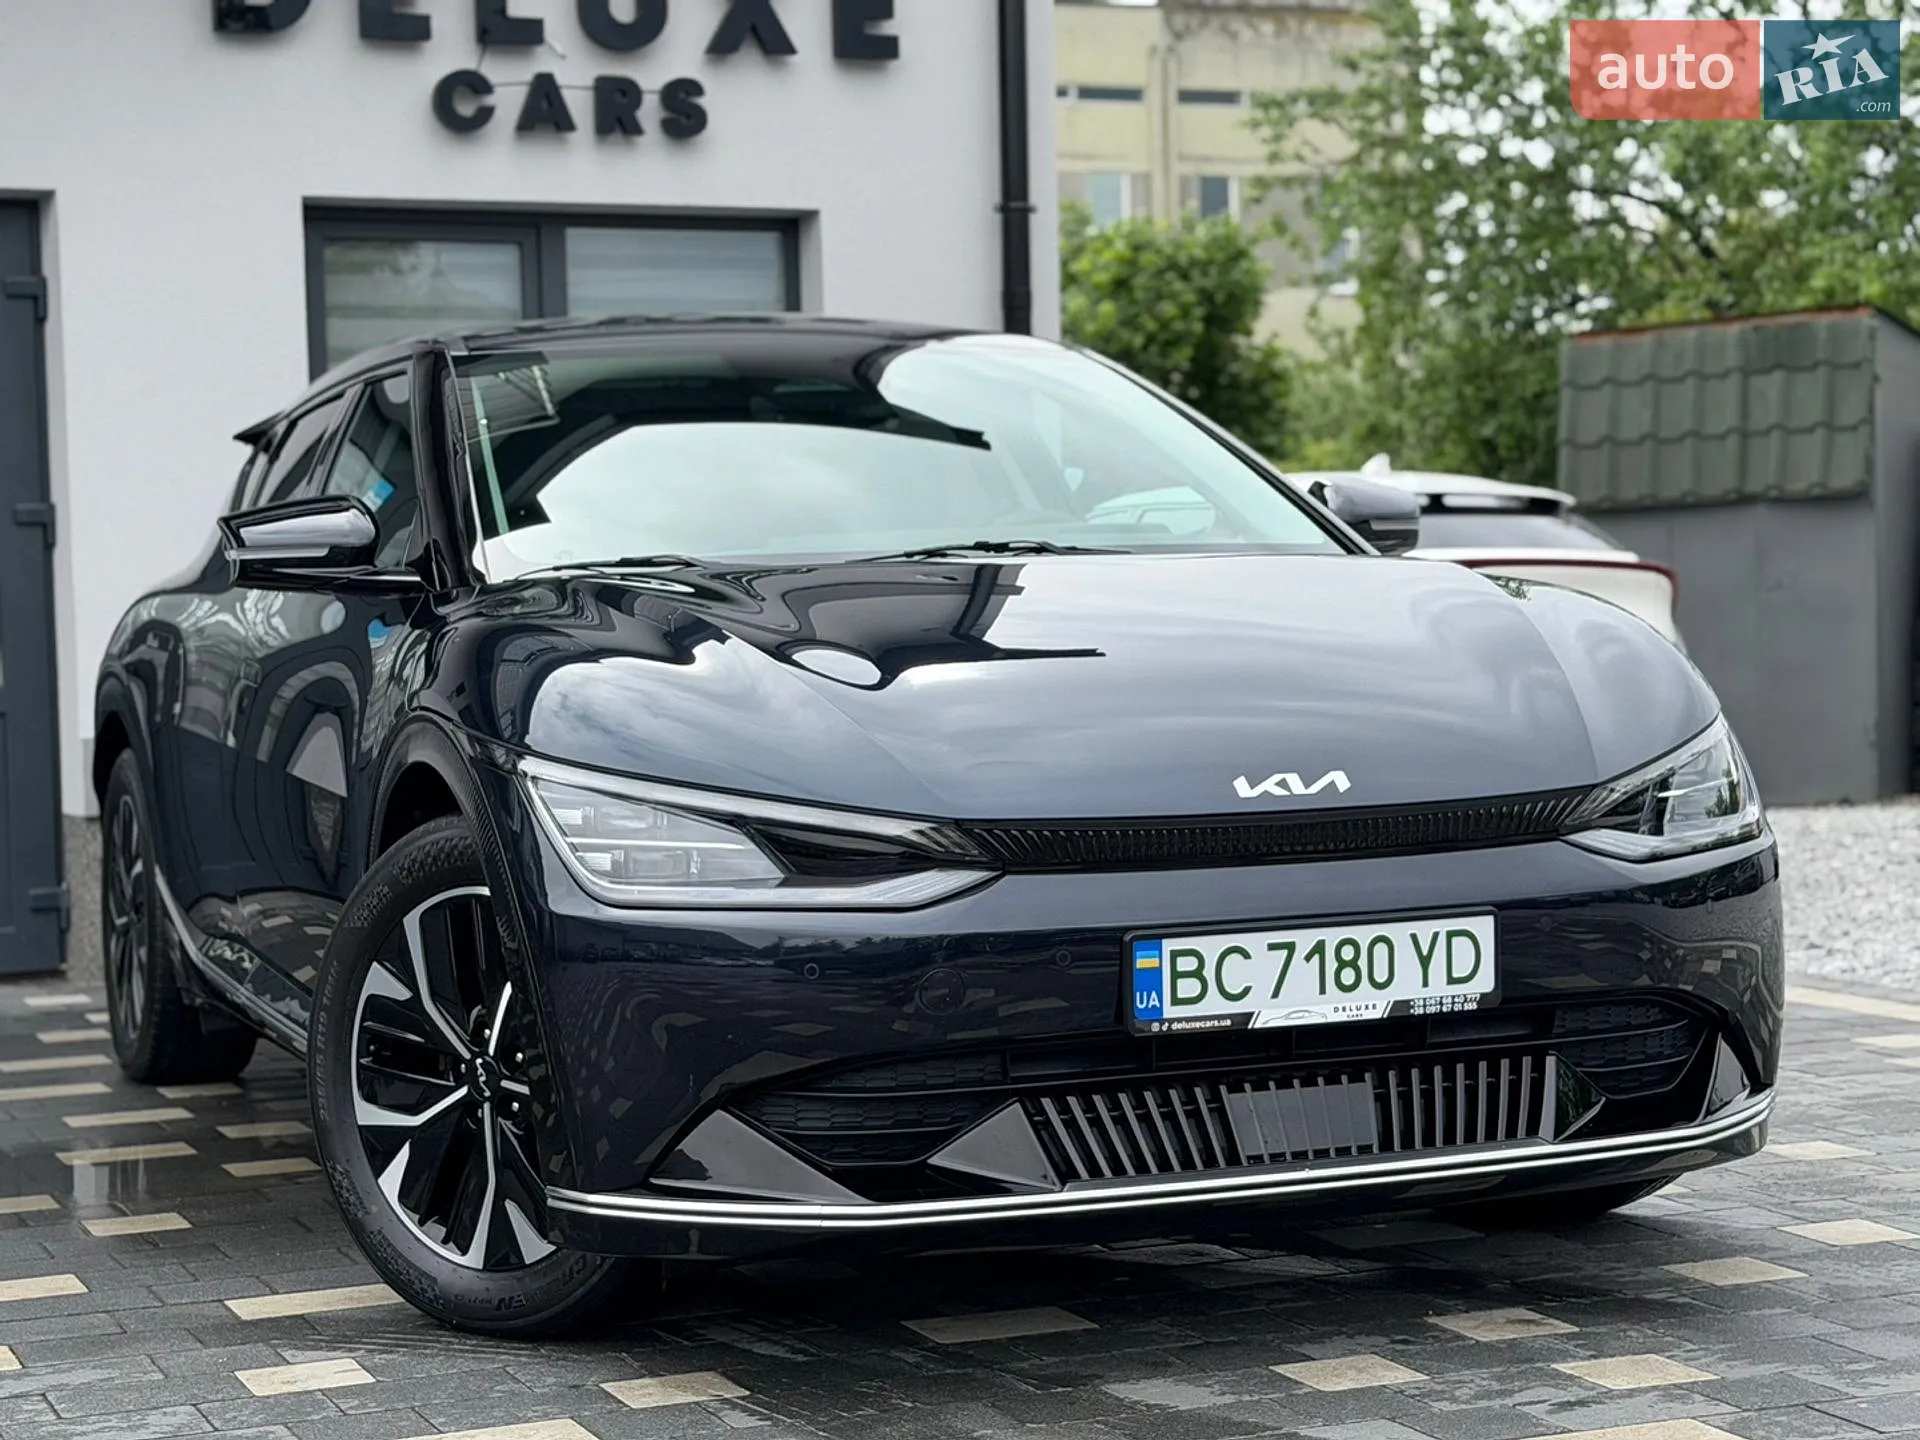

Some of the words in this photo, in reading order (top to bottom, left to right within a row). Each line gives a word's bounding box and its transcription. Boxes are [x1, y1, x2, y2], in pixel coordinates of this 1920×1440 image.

[432, 69, 708, 140] CARS
[1232, 770, 1351, 799] KIA
[1169, 945, 1253, 1007] BC
[1266, 934, 1395, 999] 7180
[1409, 928, 1482, 988] YD
[1136, 990, 1160, 1009] UA
[1333, 1003, 1378, 1014] DELUXE
